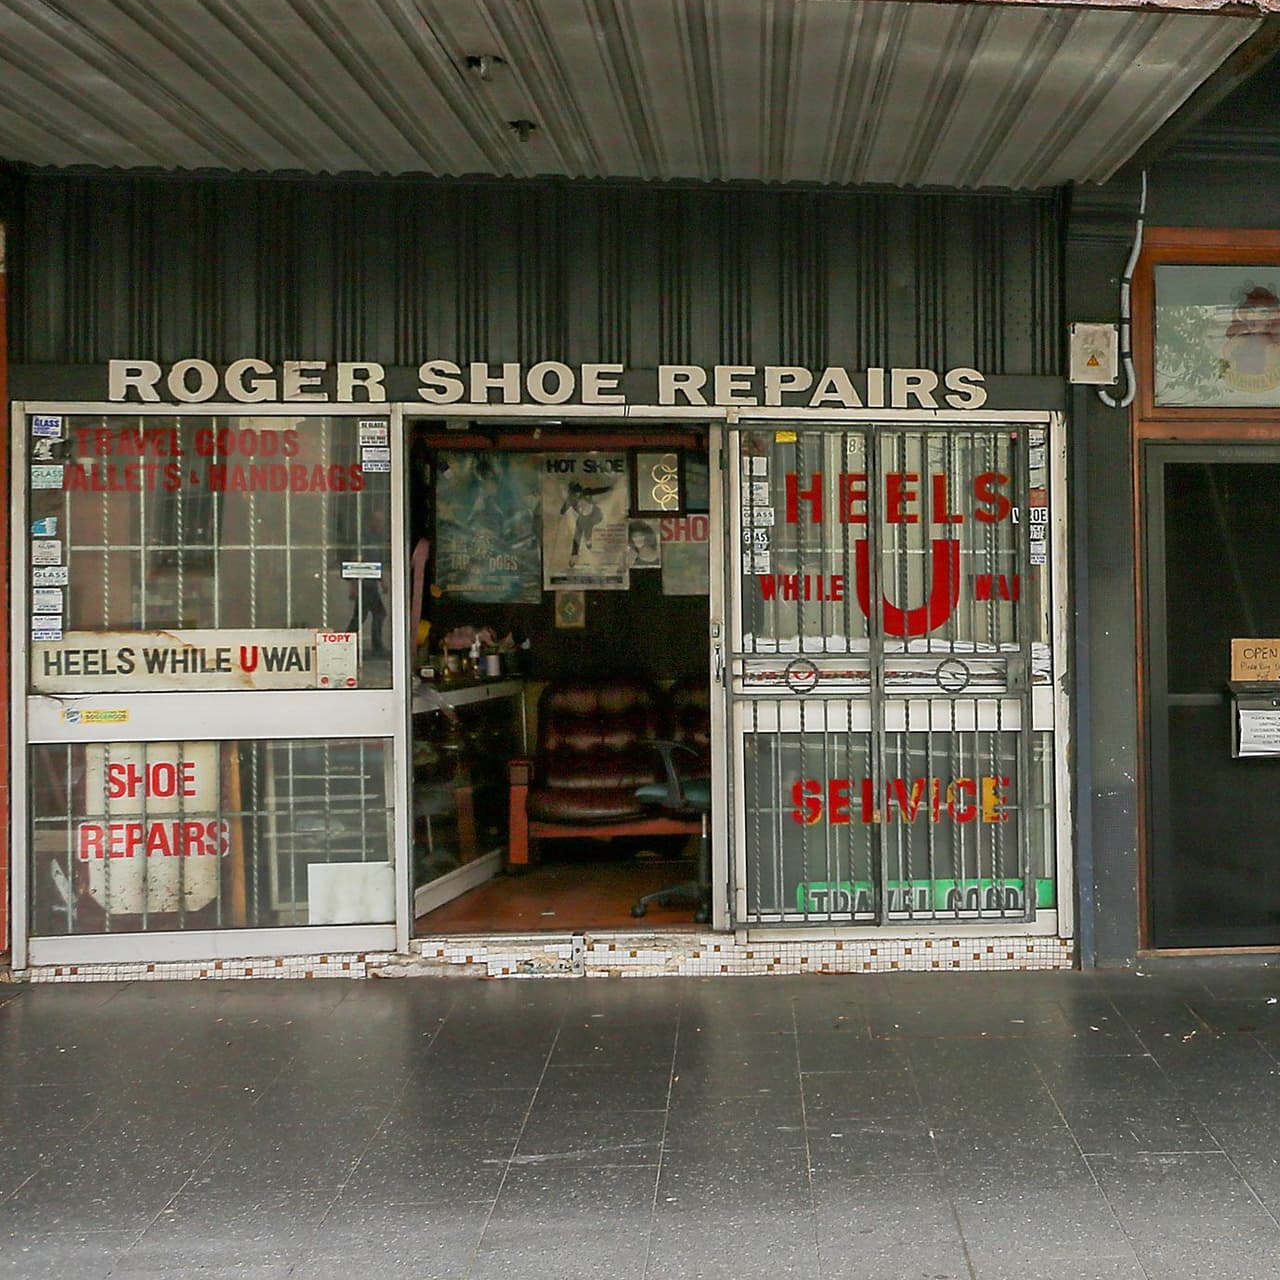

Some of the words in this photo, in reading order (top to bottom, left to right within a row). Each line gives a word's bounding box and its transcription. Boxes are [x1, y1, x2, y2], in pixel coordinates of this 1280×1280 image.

[107, 358, 389, 404] ROGER
[417, 359, 626, 406] SHOE
[657, 365, 989, 409] REPAIRS
[73, 428, 185, 457] TRAVEL
[195, 428, 300, 458] GOODS
[208, 463, 367, 493] HANDBAGS
[546, 459, 576, 474] HOT
[785, 472, 1012, 525] HEELS
[660, 516, 708, 542] SHO
[34, 571, 67, 579] GLASS
[760, 574, 844, 602] WHILE
[855, 539, 961, 637] U
[975, 574, 1036, 602] WAI
[321, 634, 351, 643] TOPY
[1243, 647, 1278, 660] OPEN
[43, 647, 136, 676] HEELS
[143, 647, 232, 674] WHILE
[240, 645, 259, 673] U
[262, 646, 317, 673] WAI
[109, 761, 196, 799] SHOE
[79, 820, 229, 859] REPAIRS
[945, 886, 1036, 911] GOOD
